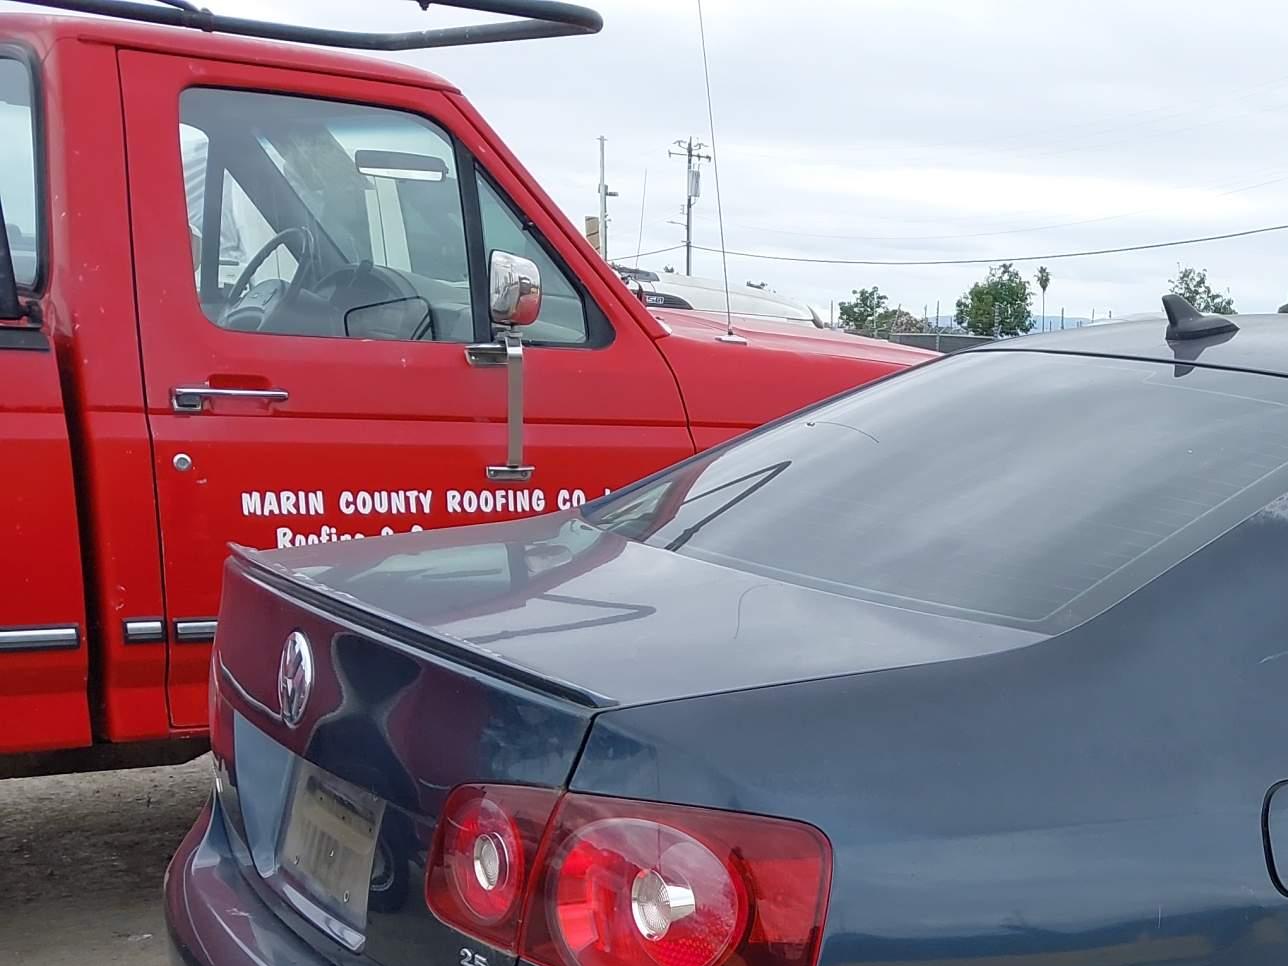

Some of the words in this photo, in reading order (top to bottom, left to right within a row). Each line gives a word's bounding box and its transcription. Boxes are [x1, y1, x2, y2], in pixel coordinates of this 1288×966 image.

[241, 491, 325, 516] MARIN
[339, 490, 433, 515] COUNTY
[446, 489, 545, 513] ROOFING
